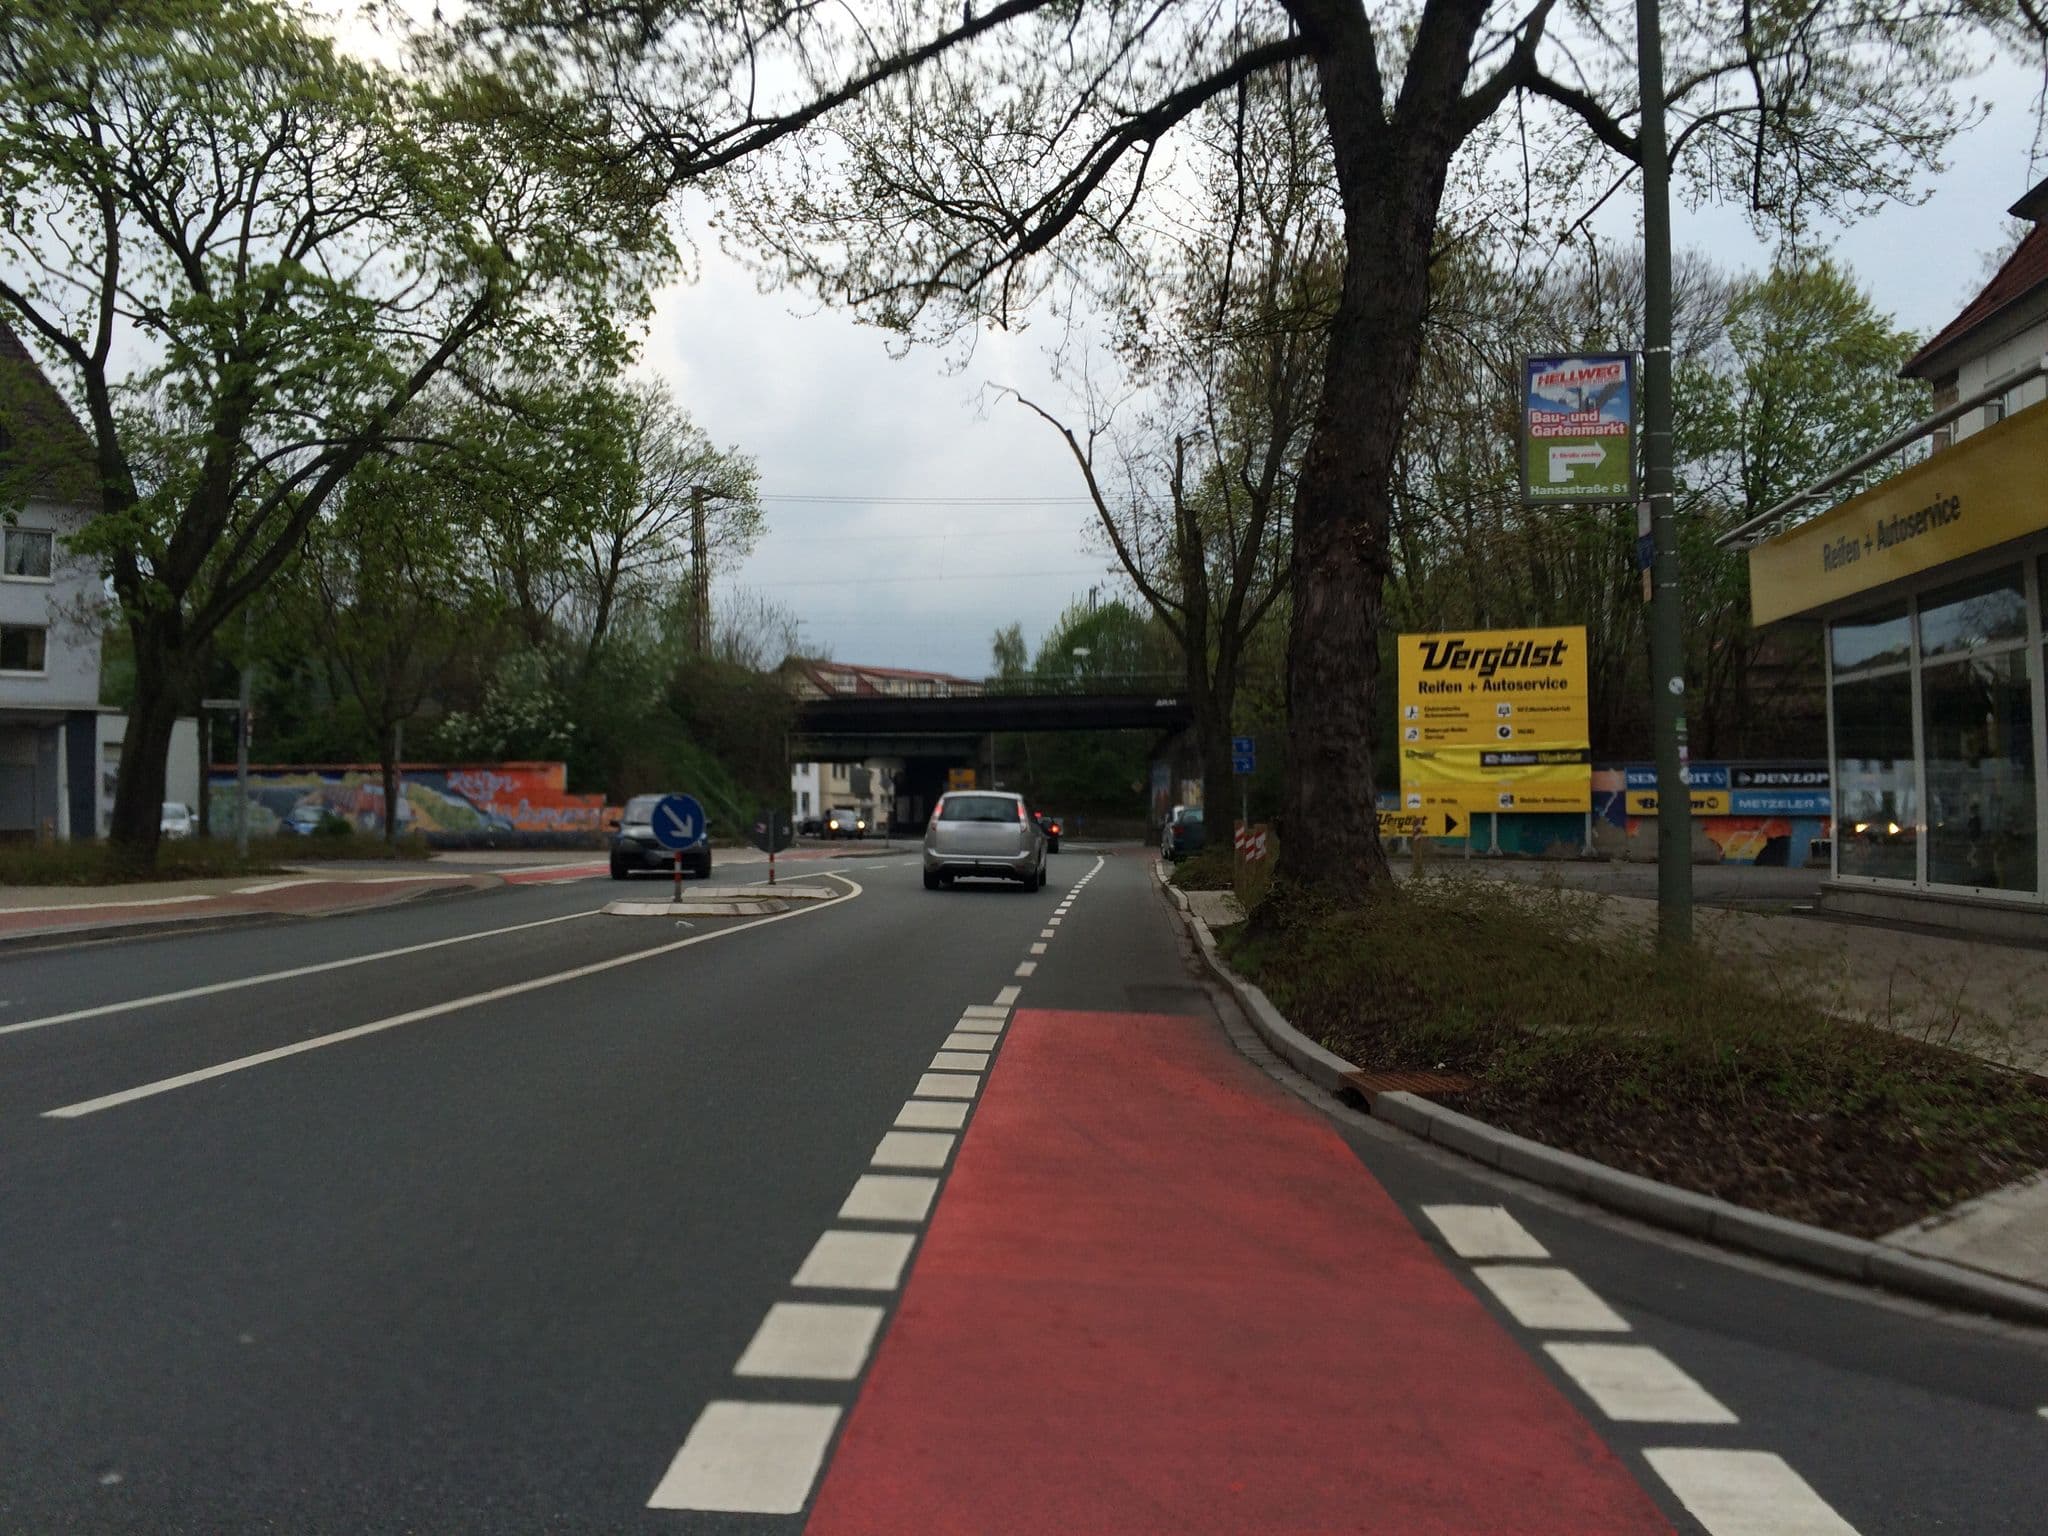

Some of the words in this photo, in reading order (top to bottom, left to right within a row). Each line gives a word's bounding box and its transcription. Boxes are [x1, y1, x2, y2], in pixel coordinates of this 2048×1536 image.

[1537, 365, 1621, 386] HELLWEG
[1532, 411, 1566, 423] Bau-
[1570, 410, 1598, 422] und
[1532, 423, 1625, 437] Gartenmarkt
[1530, 484, 1609, 495] Hansastraße
[1613, 483, 1628, 493] 81
[1823, 535, 1861, 572] Reifen
[1876, 493, 1962, 551] Autoservice
[1419, 638, 1568, 677] Vergölst
[1418, 680, 1462, 694] Reifen
[1467, 683, 1478, 693] +
[1482, 677, 1568, 692] Autoservice
[1753, 772, 1830, 784] DUNLOP
[1738, 798, 1814, 809] METZELER
